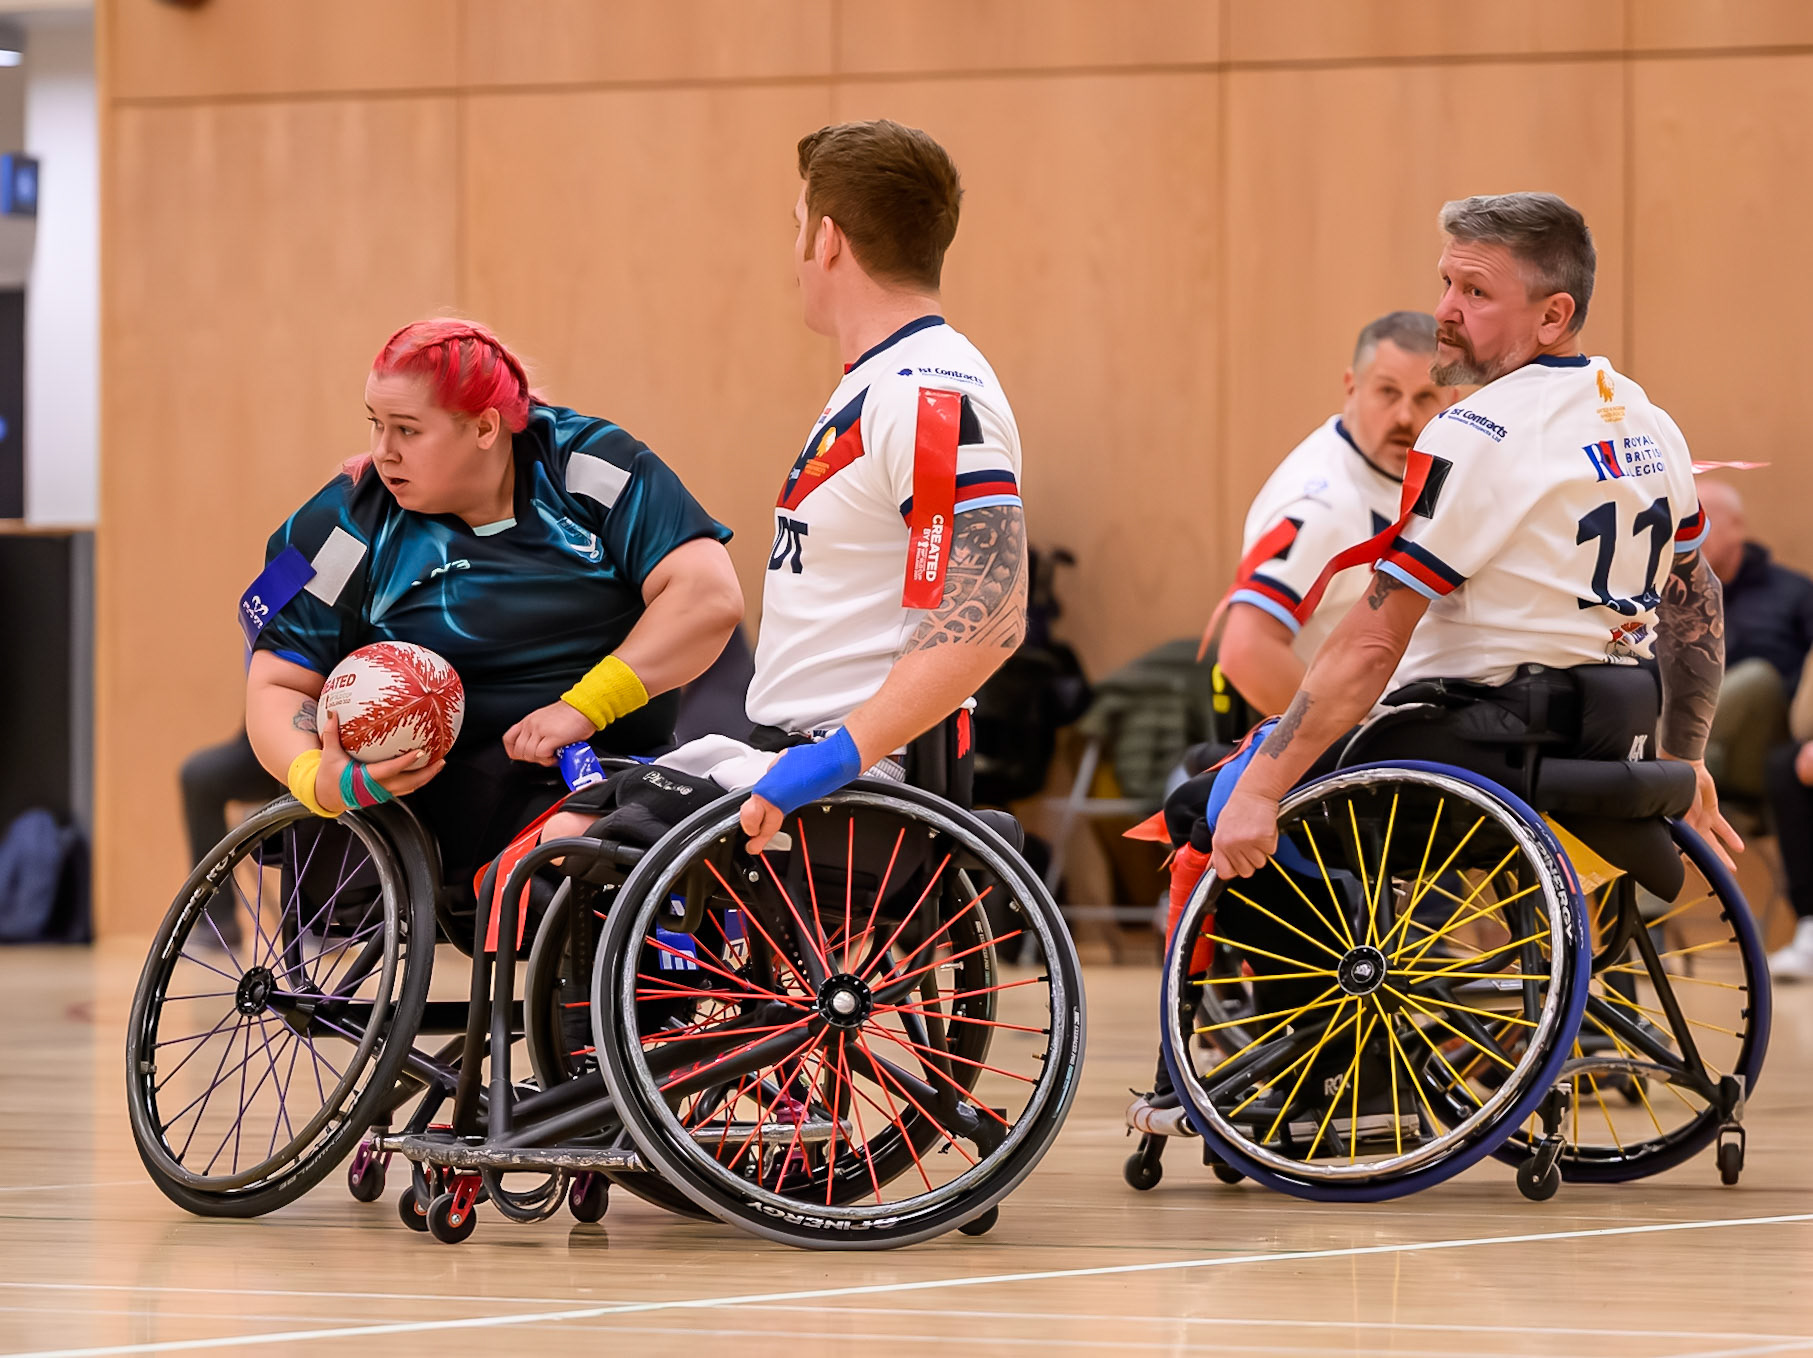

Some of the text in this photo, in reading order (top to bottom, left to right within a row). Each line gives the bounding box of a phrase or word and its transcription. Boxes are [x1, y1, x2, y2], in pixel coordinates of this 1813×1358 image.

[934, 367, 984, 384] Contracts
[1462, 409, 1508, 438] Contracts
[1623, 434, 1655, 449] ROYAL
[1627, 461, 1666, 478] LEGIO
[922, 527, 931, 541] BY
[925, 513, 945, 582] CREATED
[1576, 496, 1674, 616] 11
[321, 673, 357, 693] EATED
[745, 1200, 899, 1231] SPINERGY
